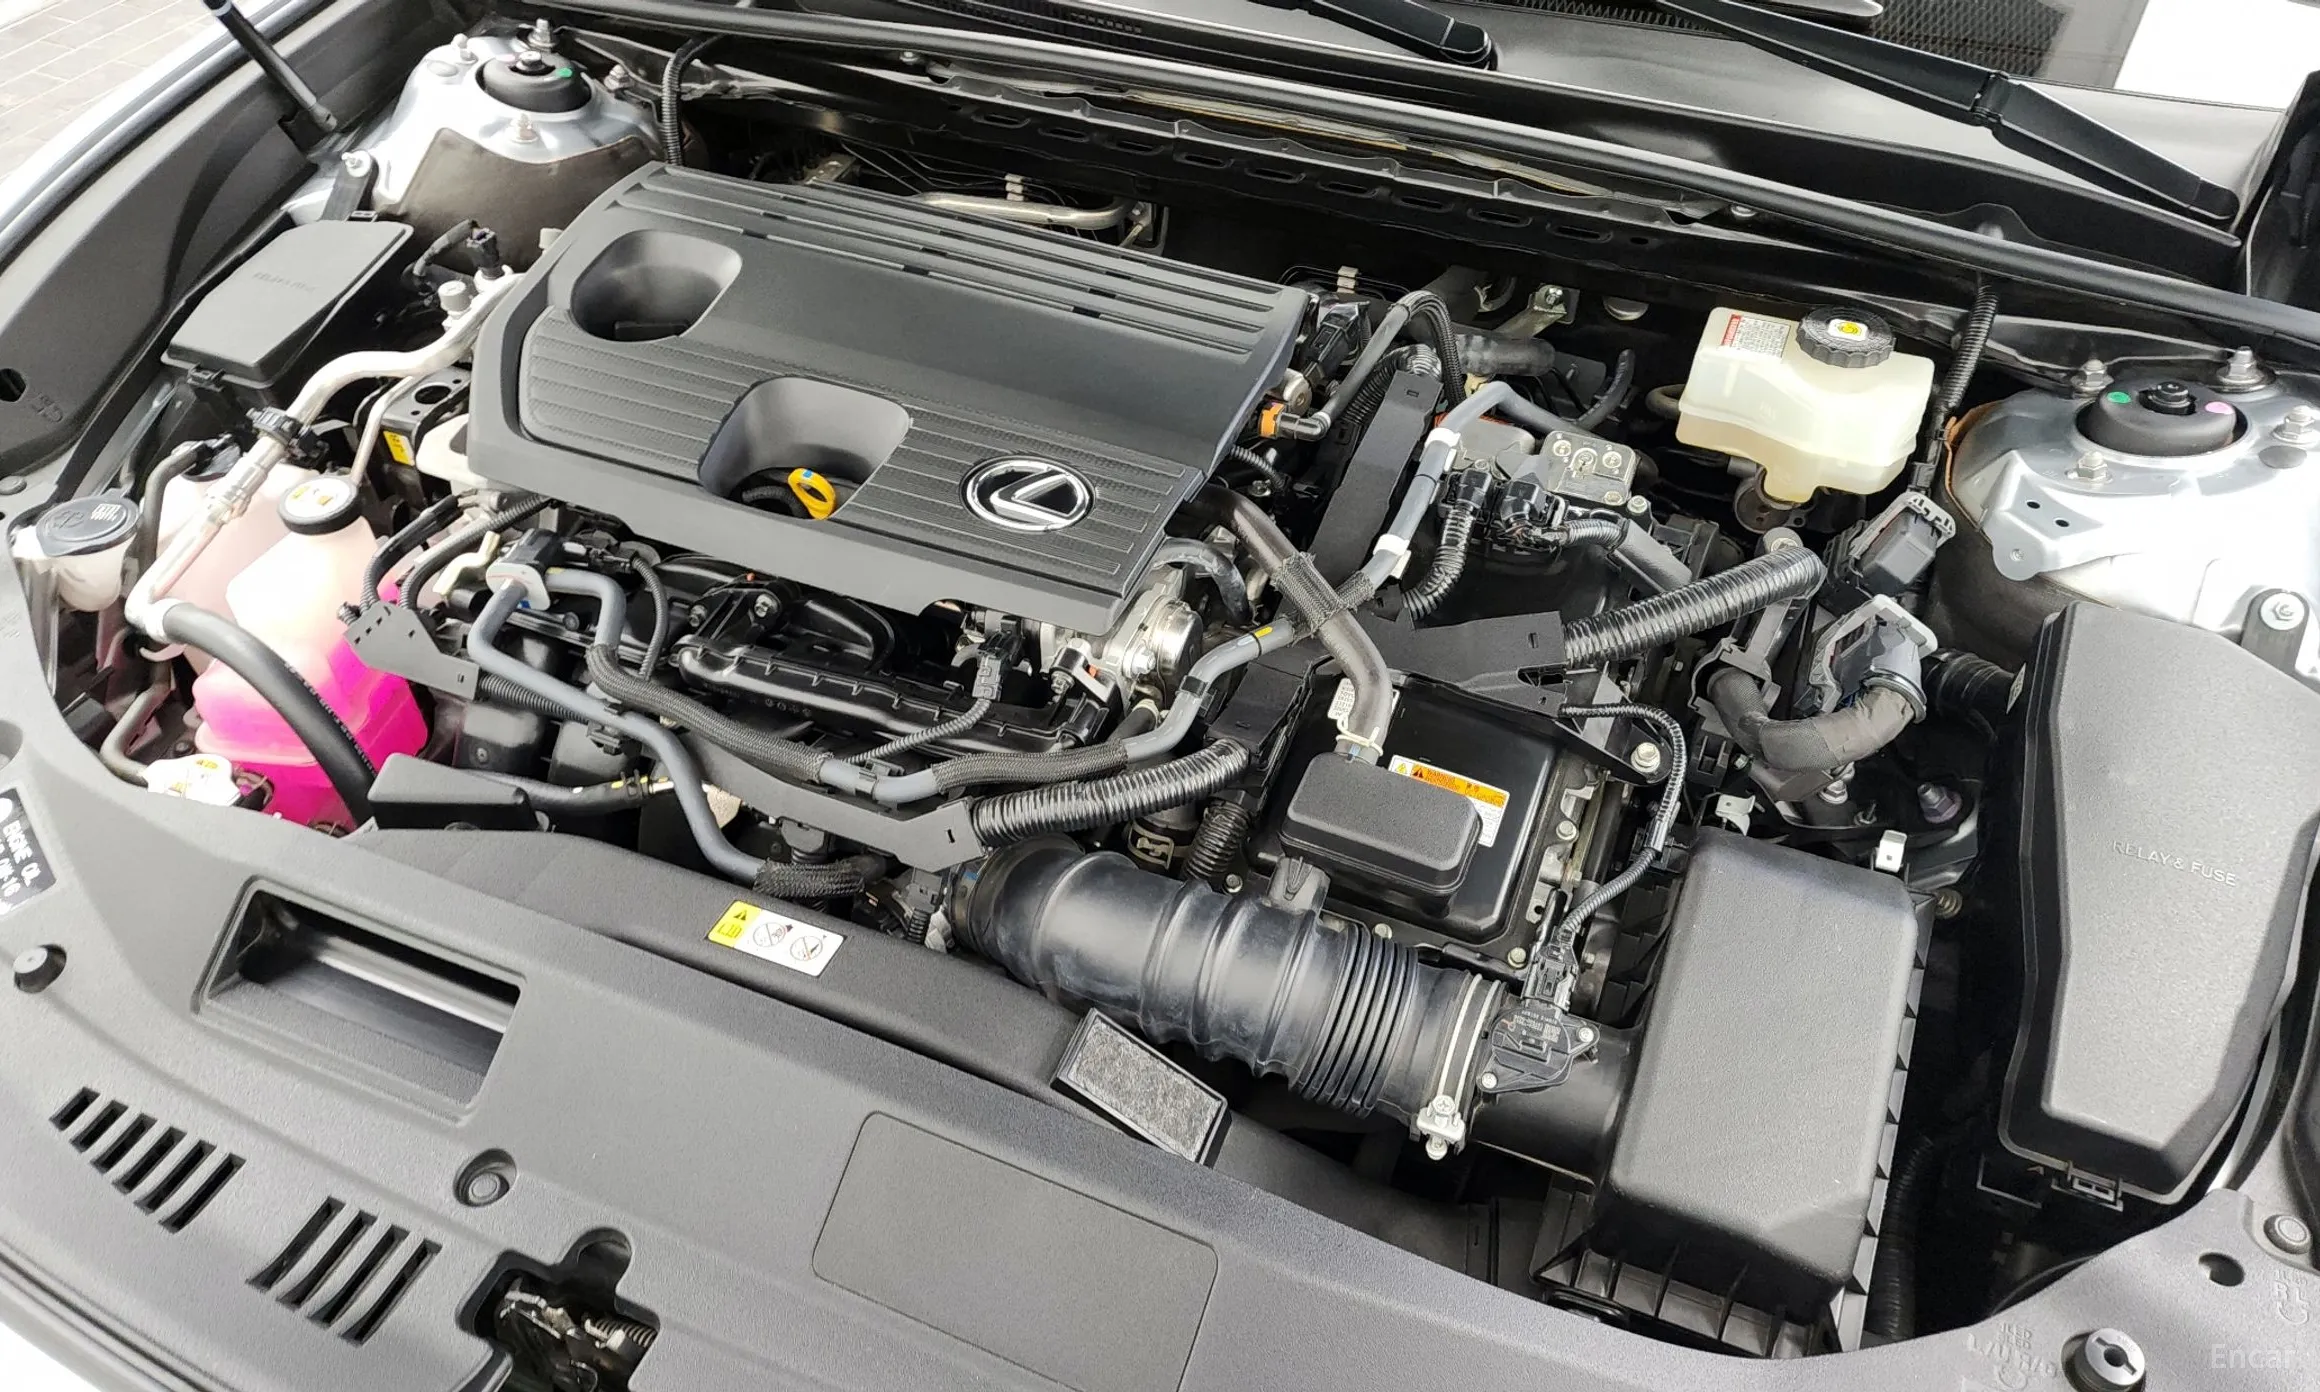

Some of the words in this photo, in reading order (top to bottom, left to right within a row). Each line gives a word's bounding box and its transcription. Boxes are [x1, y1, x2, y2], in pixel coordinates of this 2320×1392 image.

[2112, 840, 2170, 865] RELAY
[2172, 856, 2184, 871] &
[2190, 860, 2238, 886] FUSE
